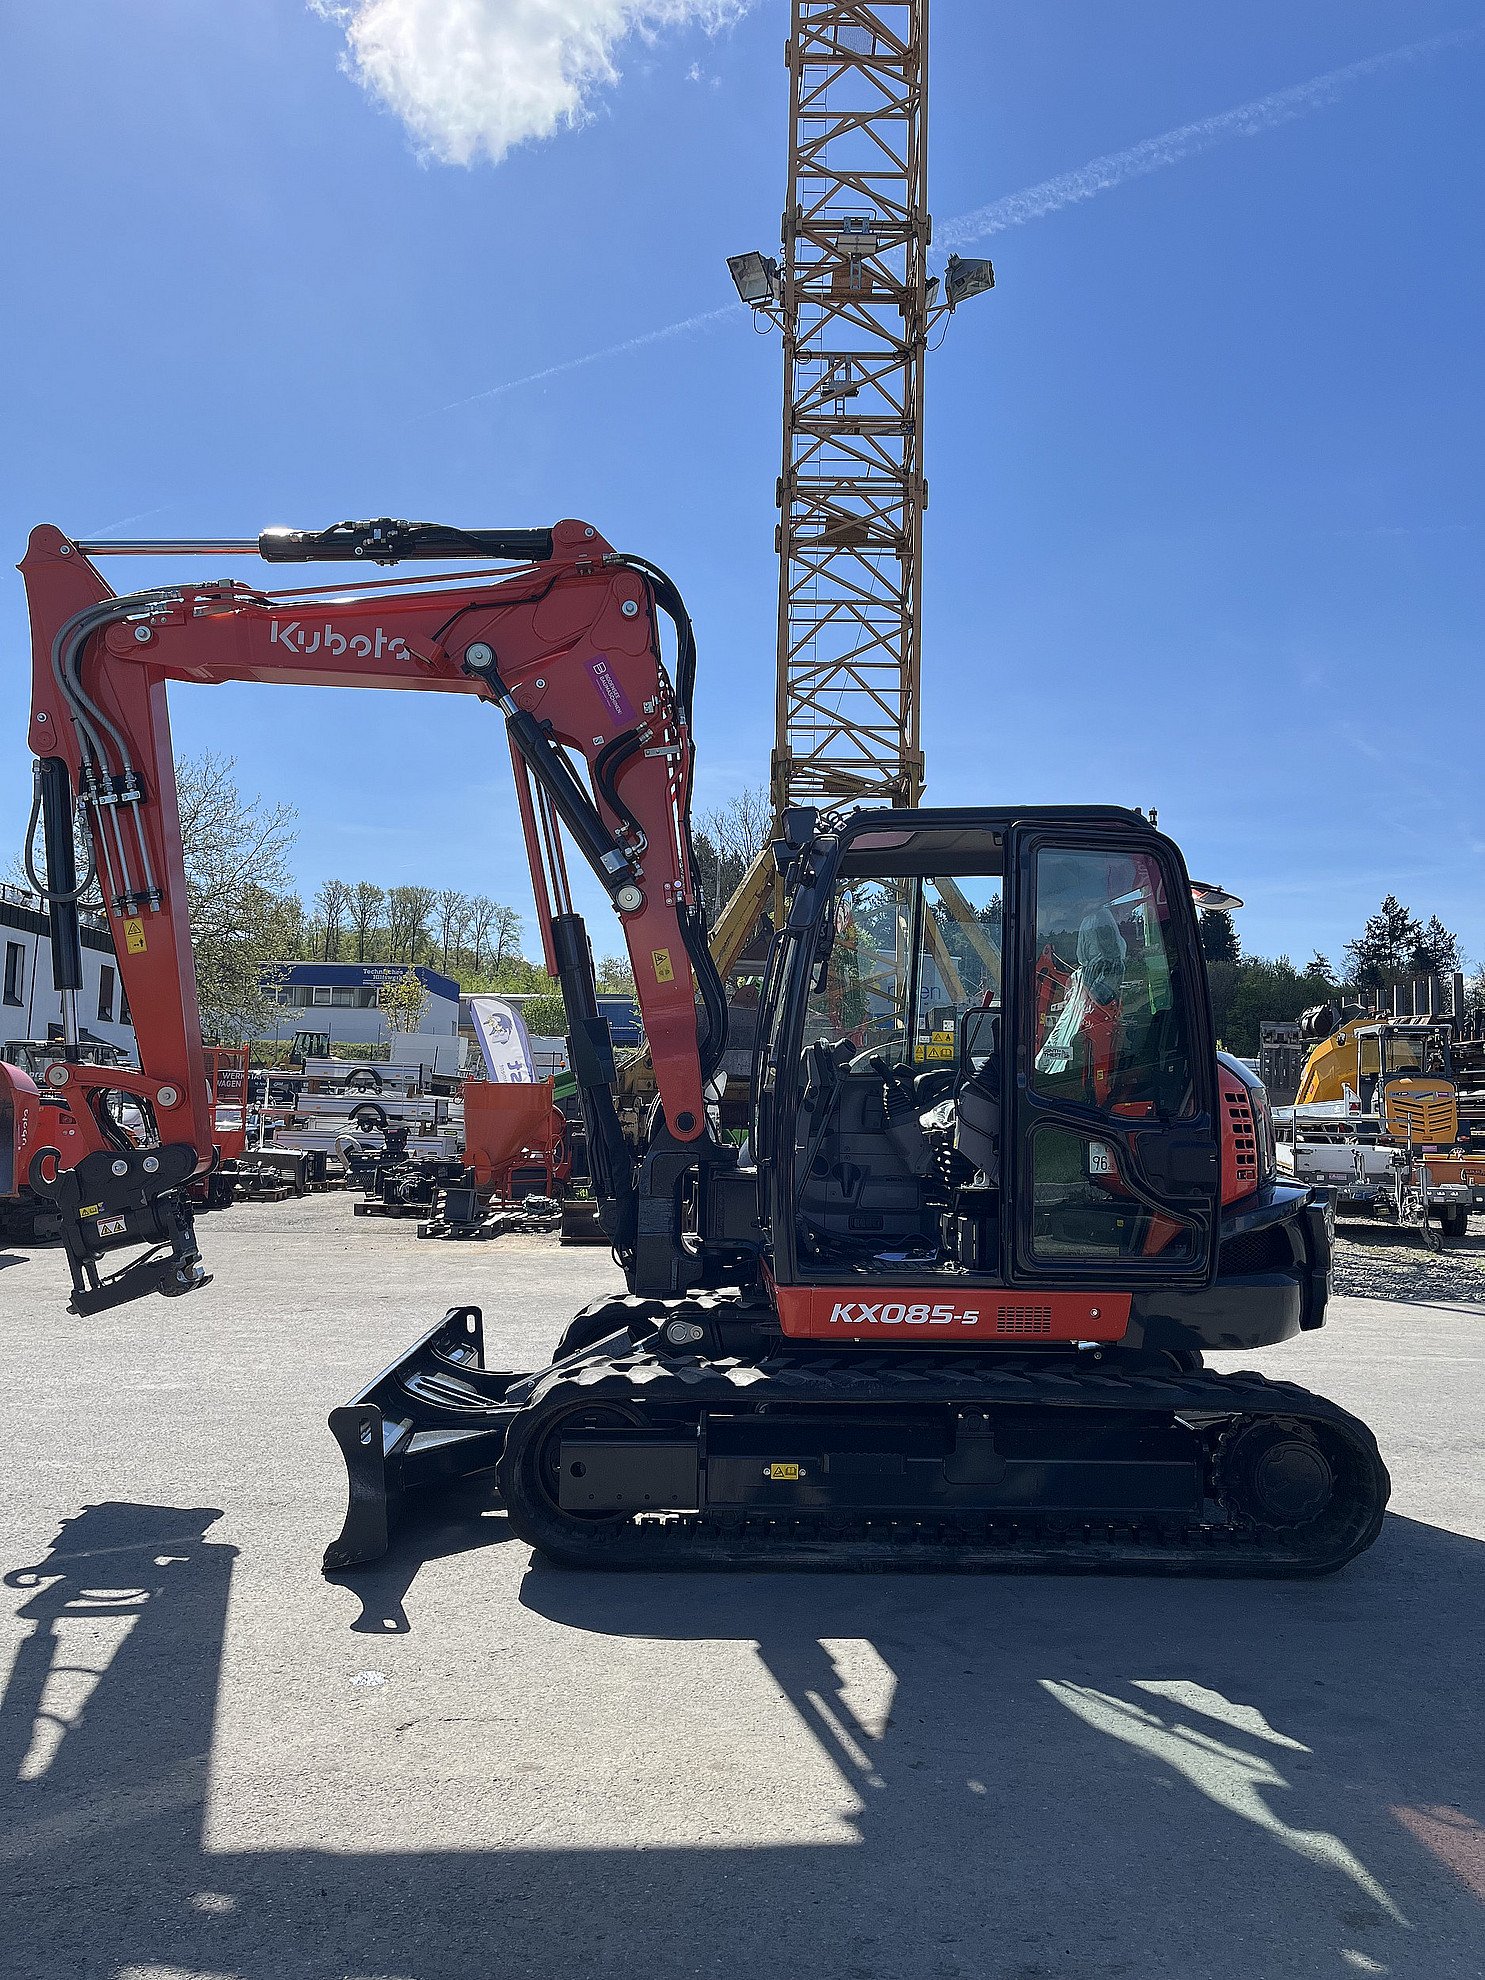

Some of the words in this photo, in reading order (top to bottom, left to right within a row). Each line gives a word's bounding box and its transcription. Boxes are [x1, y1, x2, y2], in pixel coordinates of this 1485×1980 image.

[270, 620, 410, 660] Kubota
[1092, 1156, 1108, 1171] 96
[829, 1303, 980, 1325] KX085-5
